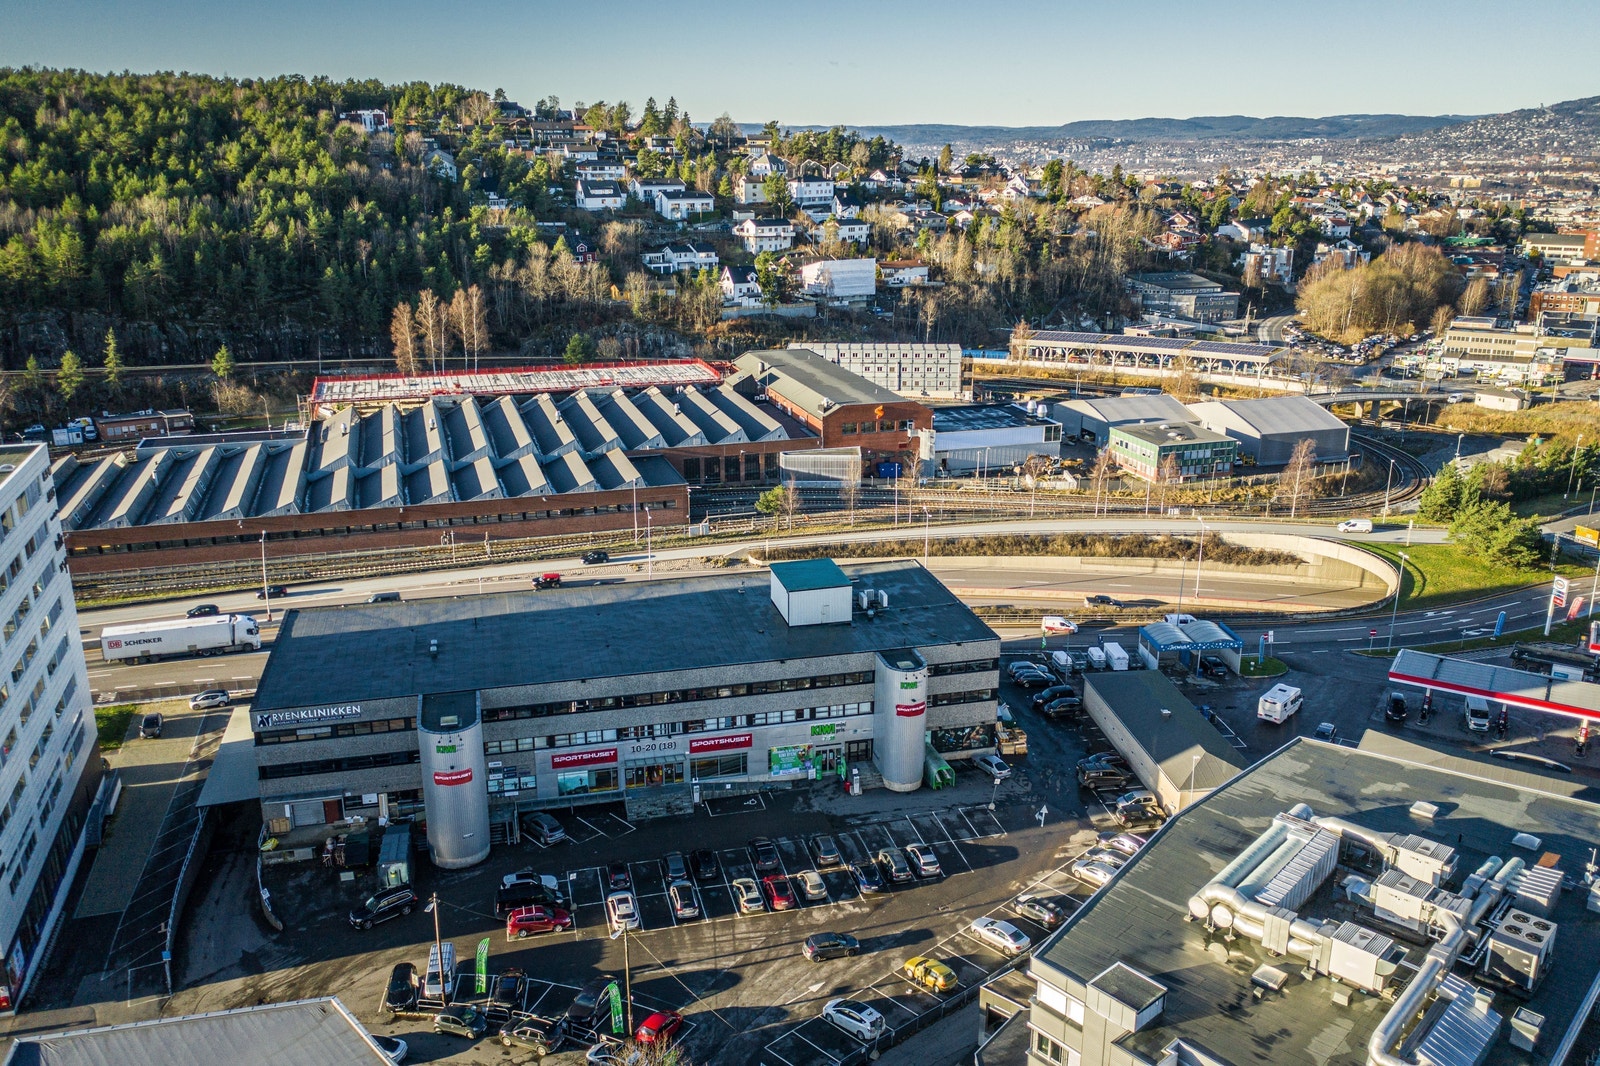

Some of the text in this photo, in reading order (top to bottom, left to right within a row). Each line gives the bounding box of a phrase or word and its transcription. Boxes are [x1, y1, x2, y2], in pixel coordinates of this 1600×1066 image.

[108, 637, 162, 649] DB SCHENKER
[272, 706, 360, 721] RYENKLINIKKEN
[811, 723, 836, 736] KIWI
[631, 741, 677, 753] 10-20 (18)
[691, 736, 751, 748] SPORTSHUSET
[436, 745, 456, 753] KIWI
[553, 750, 616, 763] SPORTSHUSET
